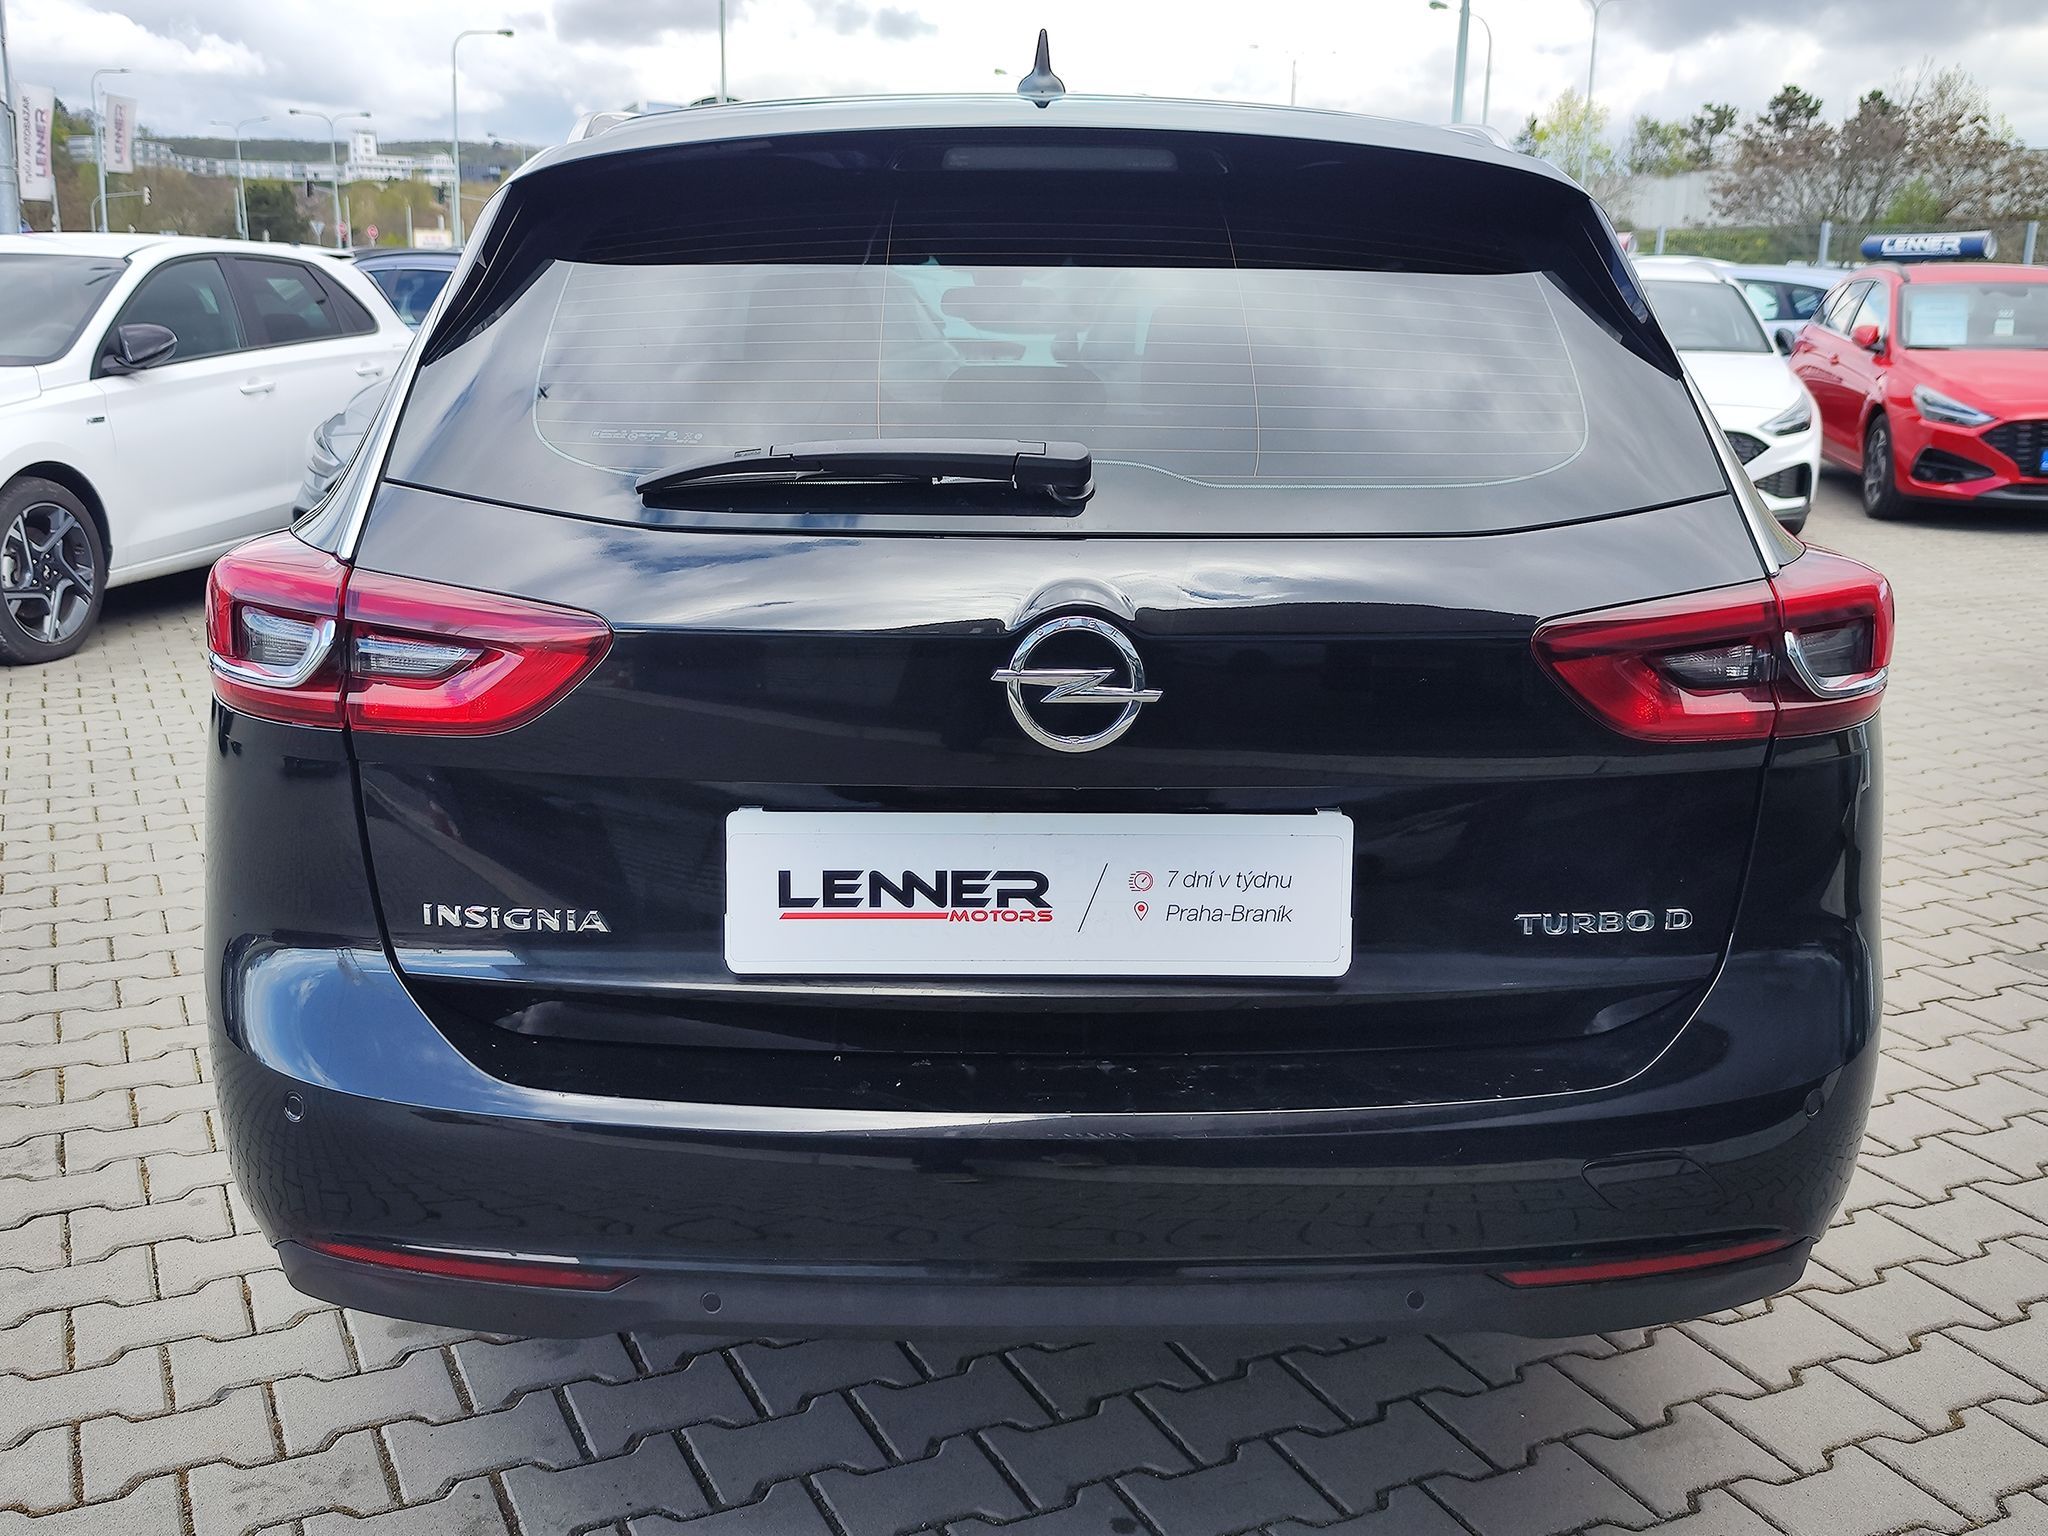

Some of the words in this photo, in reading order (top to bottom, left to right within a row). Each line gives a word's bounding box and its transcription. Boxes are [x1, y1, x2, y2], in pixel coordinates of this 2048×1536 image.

[35, 109, 47, 178] LENNER
[114, 103, 125, 164] LENNER
[1881, 235, 1961, 252] LENNER
[778, 870, 1052, 908] LENNER
[1168, 870, 1179, 888] 7
[1183, 870, 1215, 888] dní
[1219, 874, 1231, 888] v
[1236, 870, 1293, 893] týdnu
[423, 903, 611, 933] INSIGNIA
[948, 909, 1053, 923] MOTORS
[1166, 904, 1293, 923] Praha-Braník
[1514, 909, 1655, 935] TURBO
[1664, 908, 1693, 931] D
